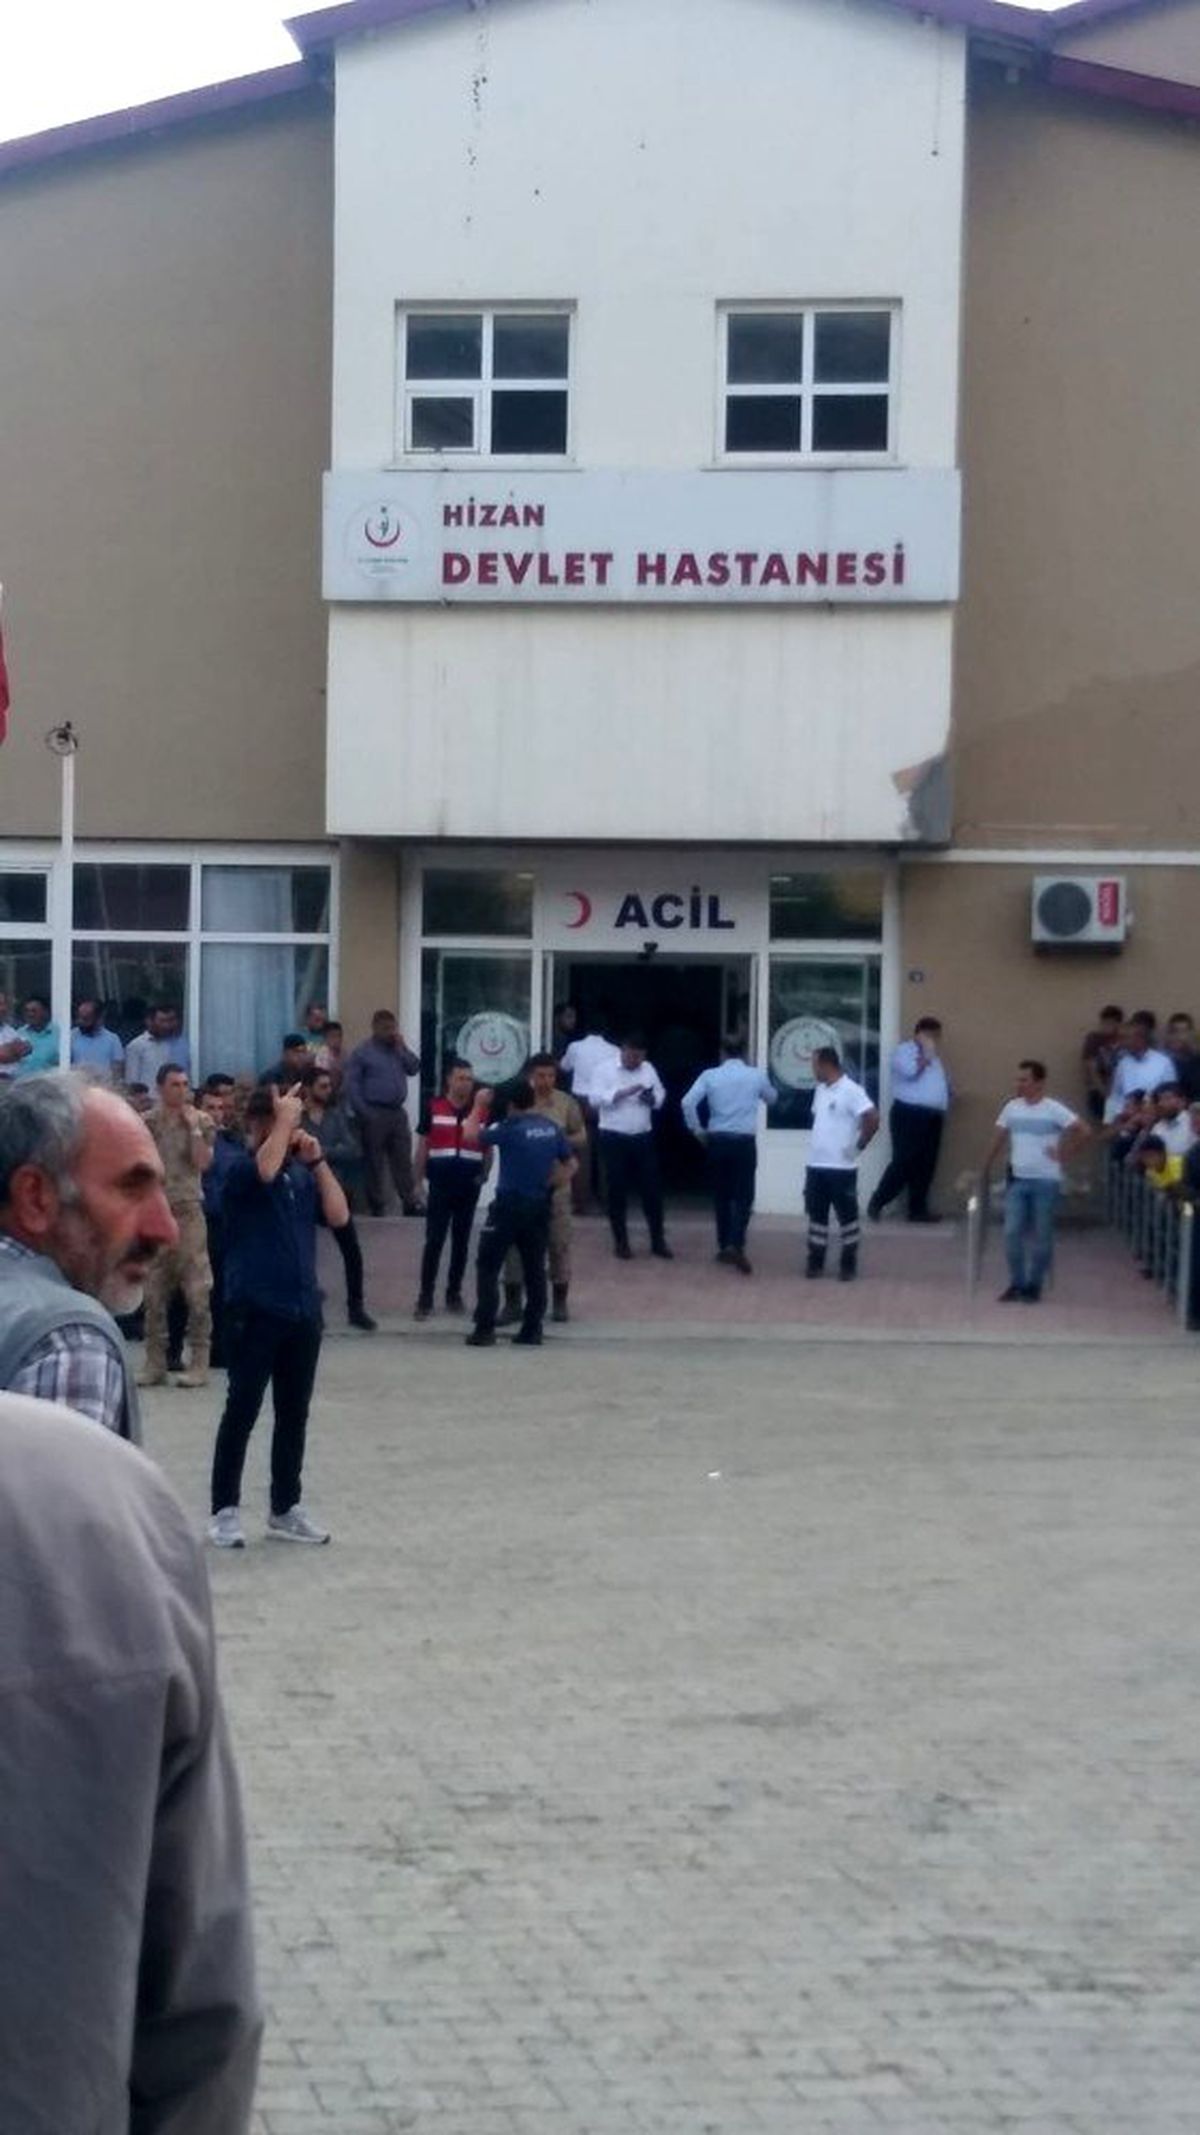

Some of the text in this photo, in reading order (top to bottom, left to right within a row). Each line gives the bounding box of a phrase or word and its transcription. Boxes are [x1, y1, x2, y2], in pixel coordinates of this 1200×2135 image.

[443, 496, 545, 527] HİZAN
[442, 542, 905, 587] DEVLET HASTANESİ
[614, 885, 735, 929] ACİL
